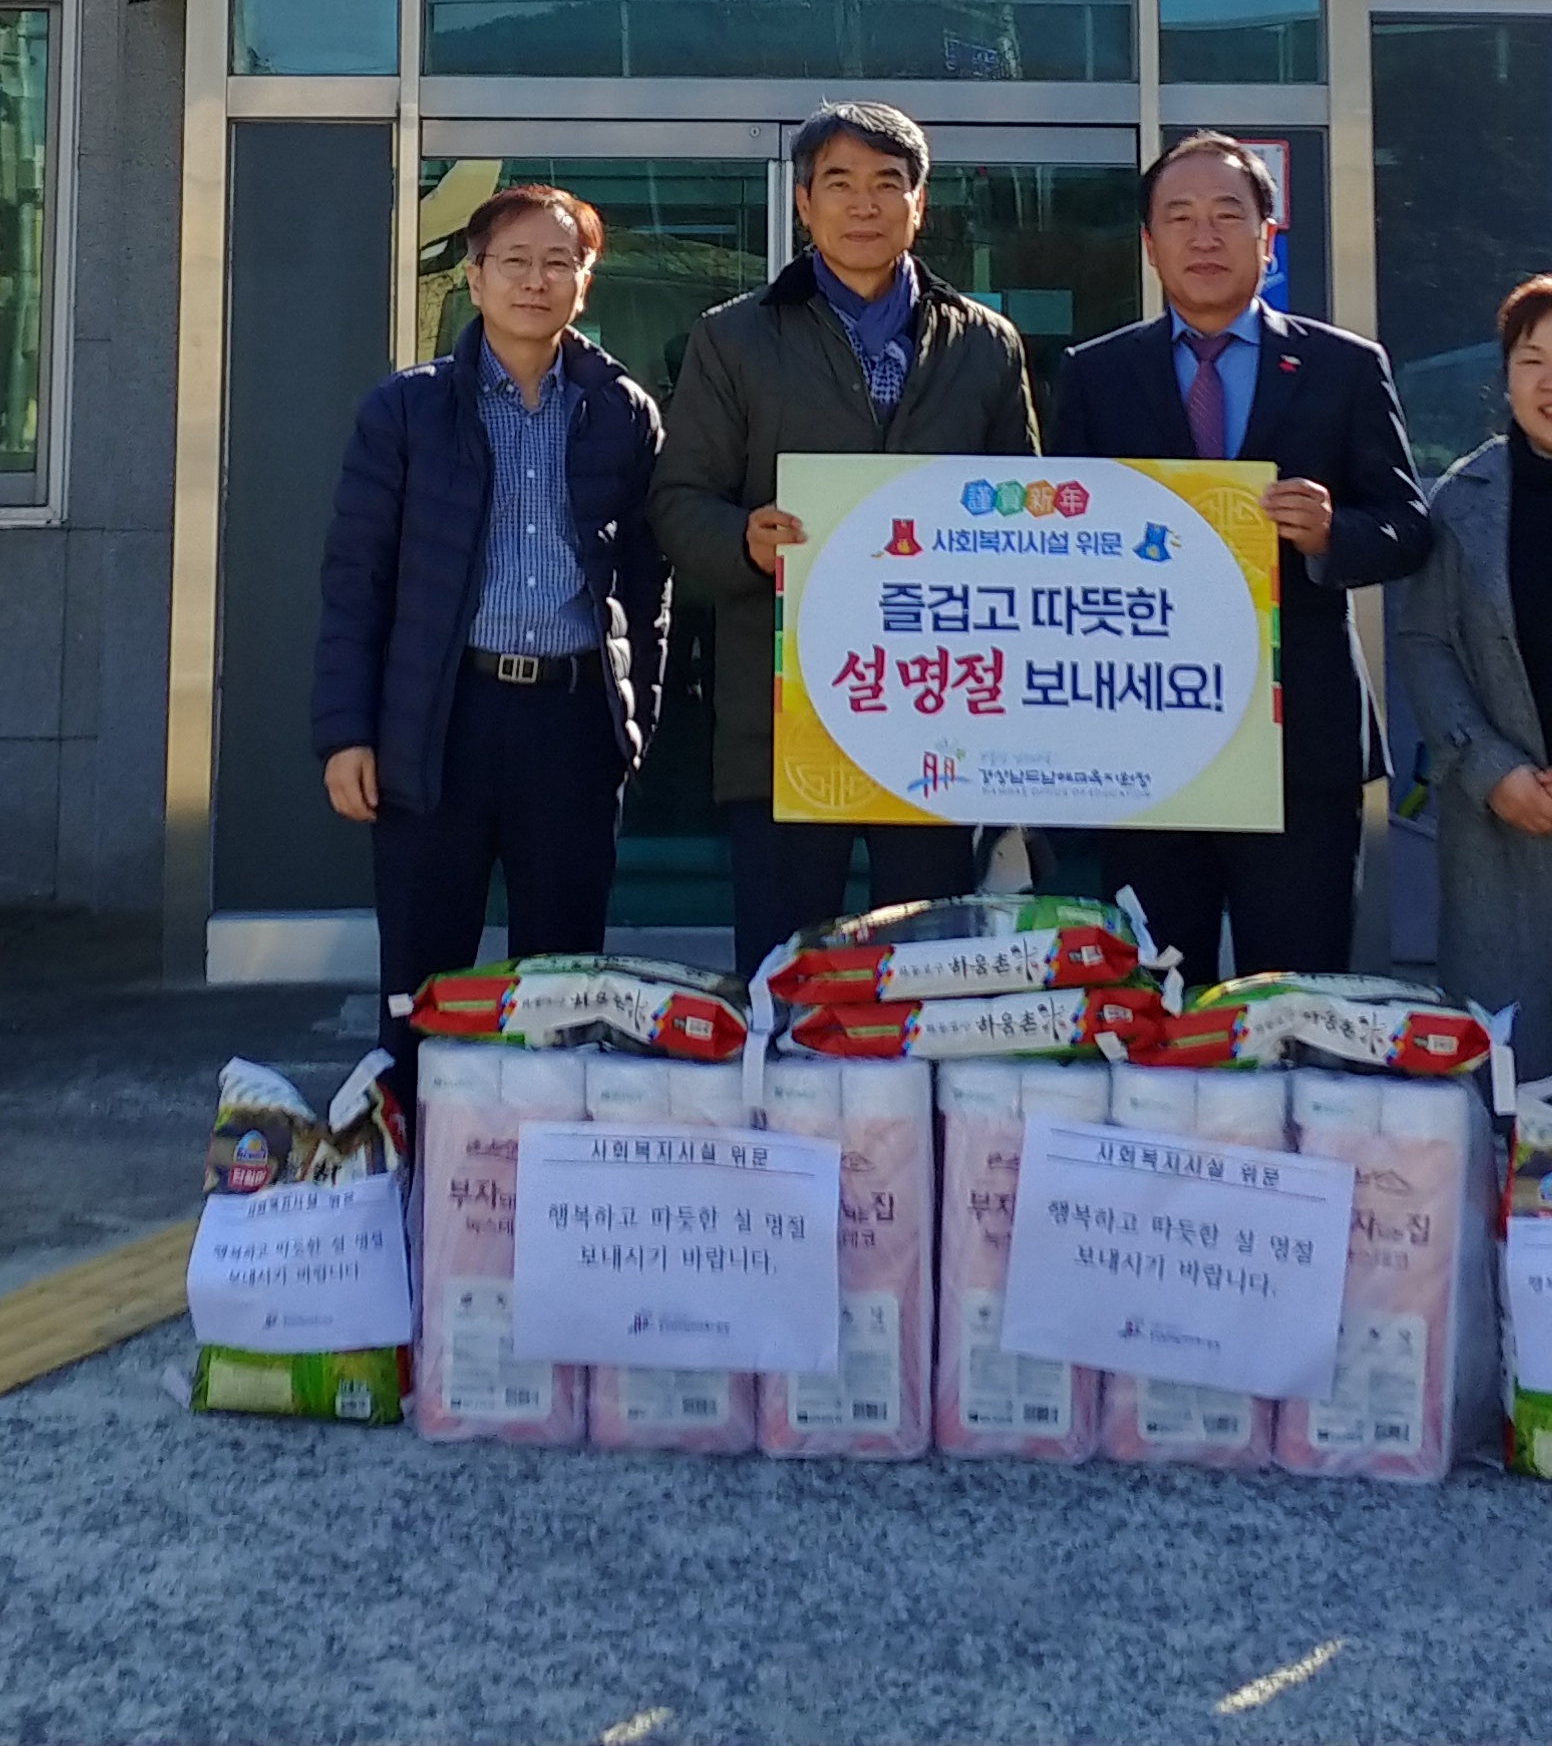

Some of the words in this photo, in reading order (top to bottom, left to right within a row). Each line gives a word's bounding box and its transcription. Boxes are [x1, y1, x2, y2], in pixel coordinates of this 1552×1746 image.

[932, 528, 1071, 555] 사회복지시설
[1076, 531, 1122, 556] 위문
[879, 582, 1020, 633] 즐겁고
[1031, 585, 1173, 638] 따뜻한
[1022, 660, 1223, 713] 보내세요!
[591, 1138, 716, 1165] 사회복지시설
[731, 1144, 768, 1170] 위문
[1098, 1141, 1224, 1181] 사회복지시설
[548, 1203, 638, 1232] 행복하고
[764, 1212, 805, 1239] 명절
[1048, 1200, 1138, 1235] 행복하고
[1269, 1234, 1314, 1266] 명절
[578, 1244, 667, 1273] 보내시기
[681, 1244, 777, 1275] 바랍니다.
[1074, 1244, 1165, 1281] 보내시기
